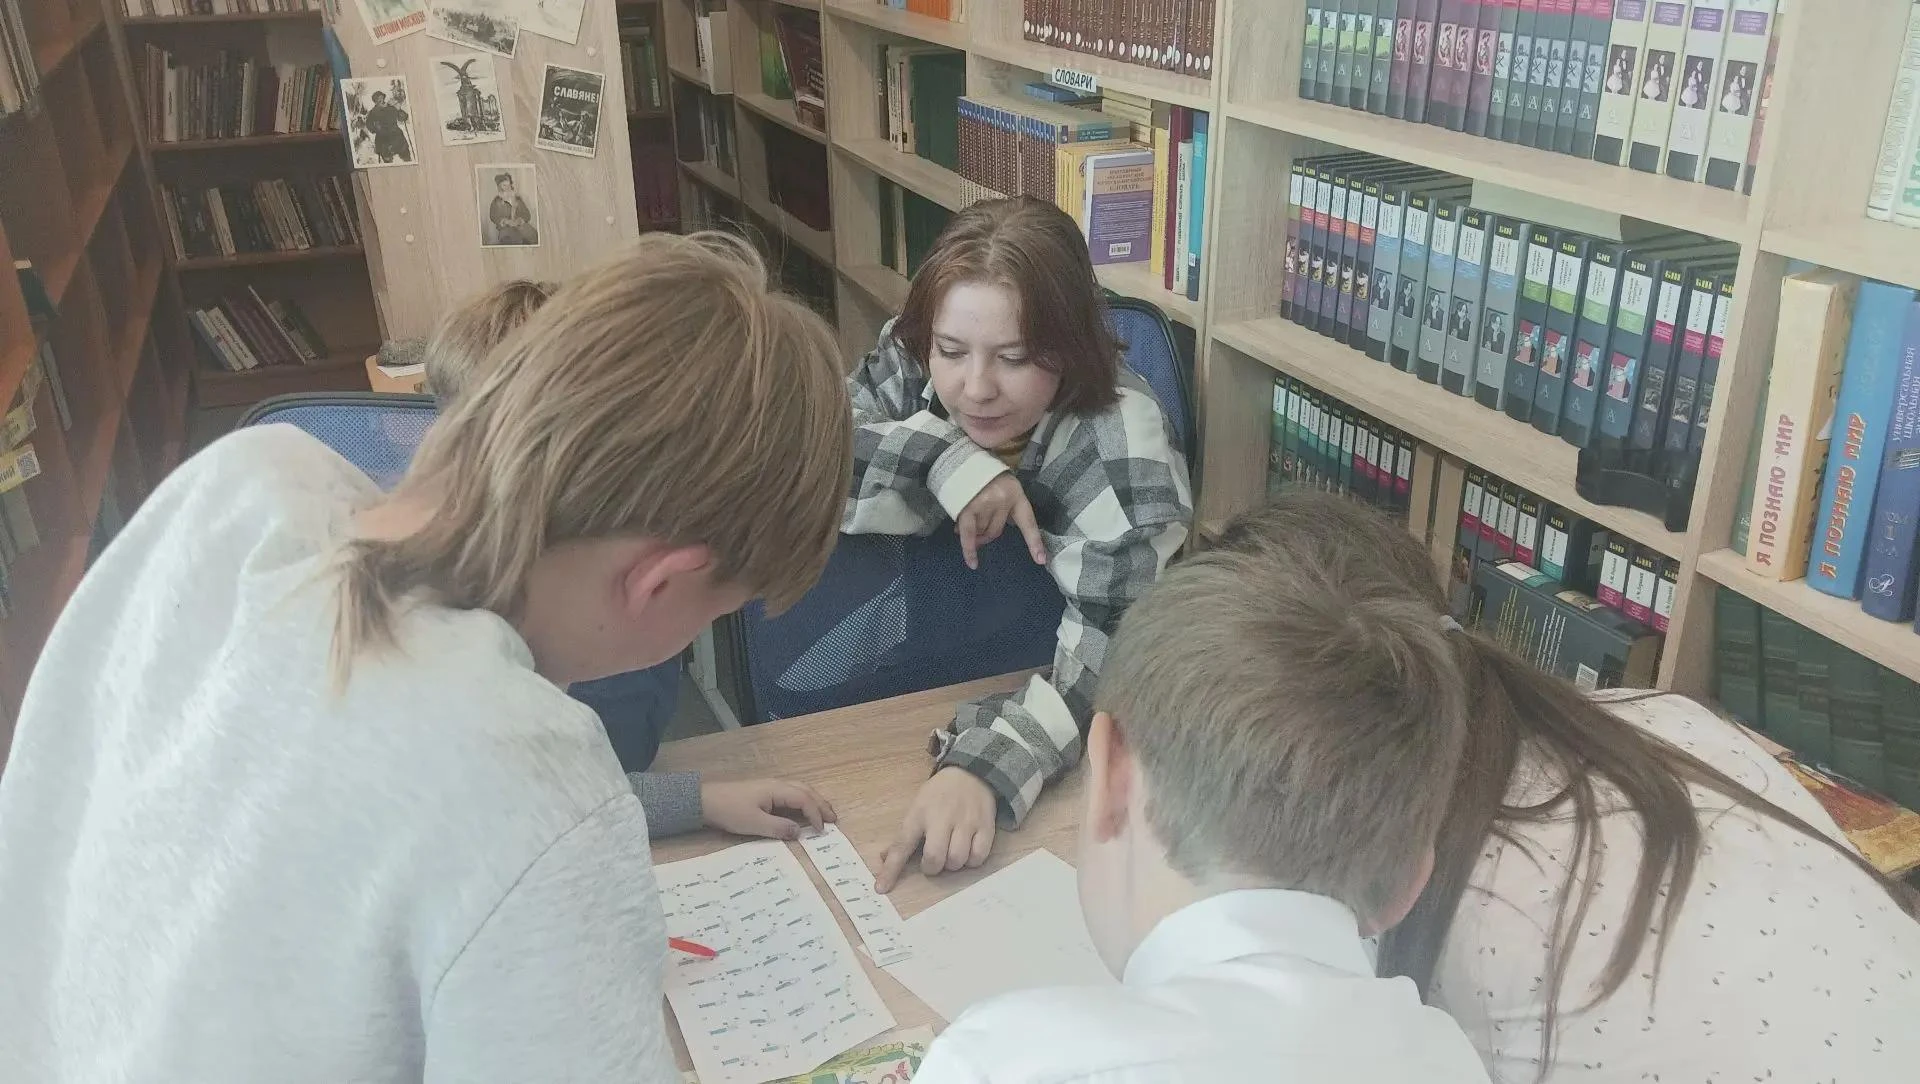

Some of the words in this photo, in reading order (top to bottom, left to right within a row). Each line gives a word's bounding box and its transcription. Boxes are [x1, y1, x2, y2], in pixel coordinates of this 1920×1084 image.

[554, 86, 599, 103] СЛАВЯНЕ!
[1055, 68, 1093, 90] СЛОВАРИ
[1775, 413, 1794, 457] МИР
[1843, 412, 1867, 461] МИР
[1759, 466, 1786, 548] ПОЗНАЮ
[1824, 464, 1857, 558] ПОЗНАЮ
[1756, 552, 1772, 567] Я
[1819, 560, 1837, 579] Я
